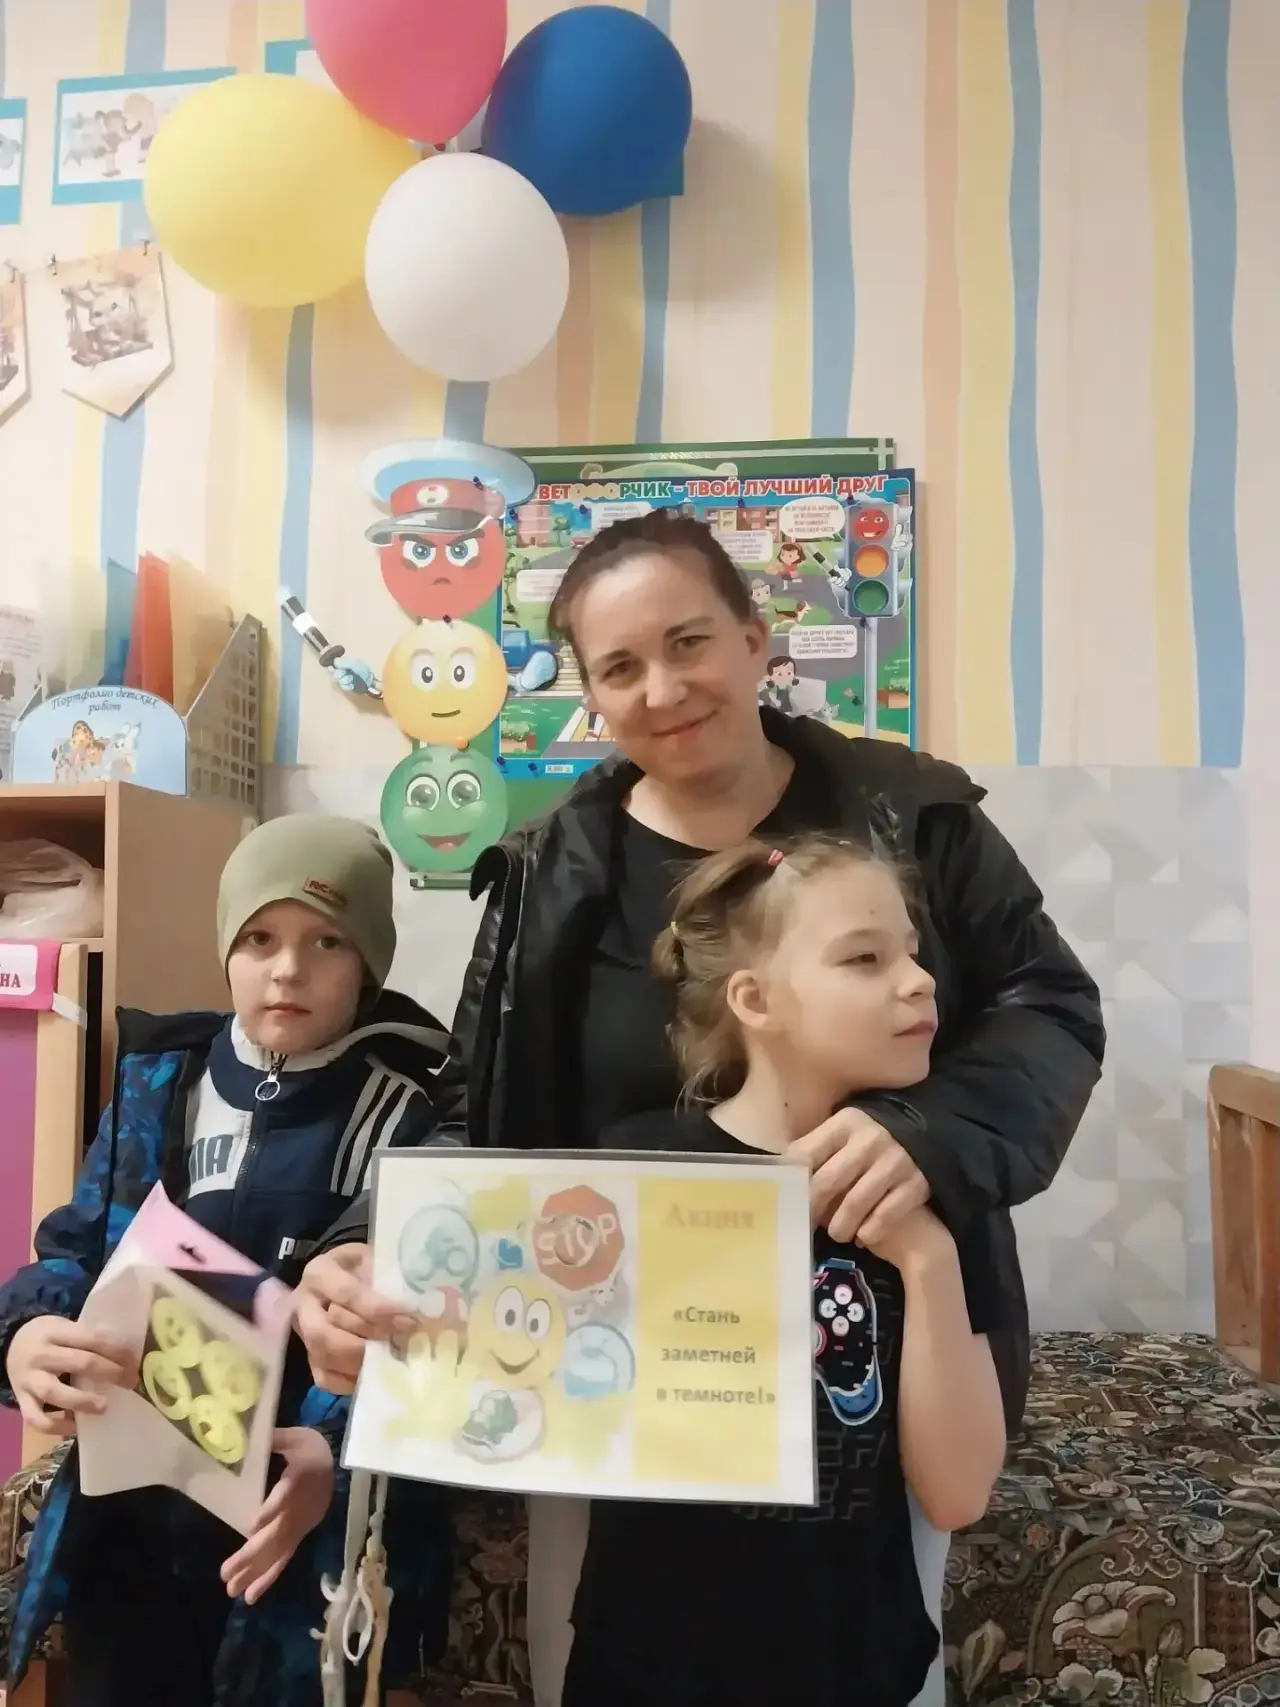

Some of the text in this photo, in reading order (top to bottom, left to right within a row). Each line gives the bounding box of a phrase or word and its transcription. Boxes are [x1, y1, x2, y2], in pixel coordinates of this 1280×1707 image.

[687, 477, 739, 496] ТВОЙ
[744, 475, 833, 495] ЛУЧШИЙ
[837, 476, 887, 495] ДРУГ
[88, 701, 121, 715] работ
[0, 974, 21, 987] НА
[674, 1306, 740, 1324] «Стань
[662, 1346, 755, 1363] заметней
